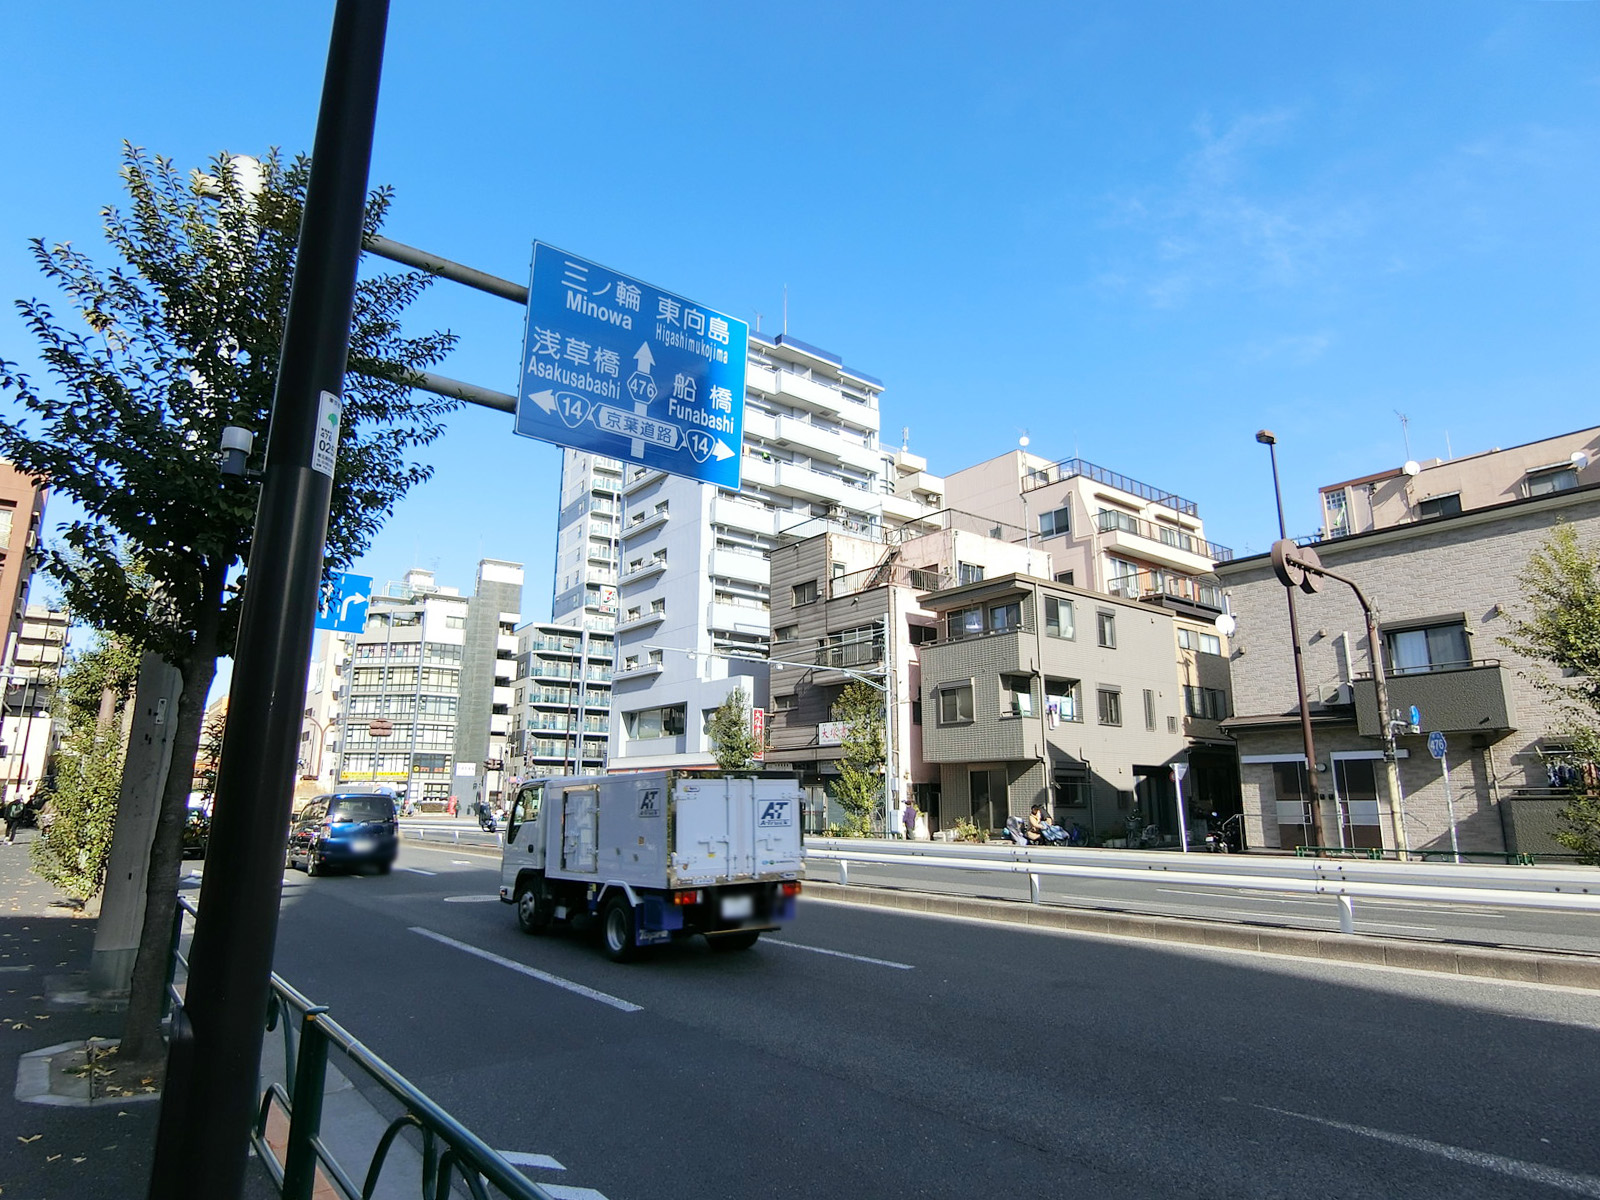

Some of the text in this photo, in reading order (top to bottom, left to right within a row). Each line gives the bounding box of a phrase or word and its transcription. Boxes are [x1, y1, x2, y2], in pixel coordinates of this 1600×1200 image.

[561, 260, 642, 312] 三ノ輪
[566, 291, 633, 330] Minowa
[656, 295, 730, 345] 東向島
[532, 326, 621, 378] 浅草橋
[656, 323, 728, 365] Higashimukojima
[527, 355, 621, 400] Asakusabashi
[629, 379, 655, 397] 476
[673, 372, 733, 414] 船橋
[562, 397, 583, 420] 14
[668, 398, 734, 434] Funabashi
[605, 411, 673, 444] 京葉道路
[691, 435, 709, 454] 14
[1430, 739, 1445, 750] 476
[760, 801, 789, 819] AT
